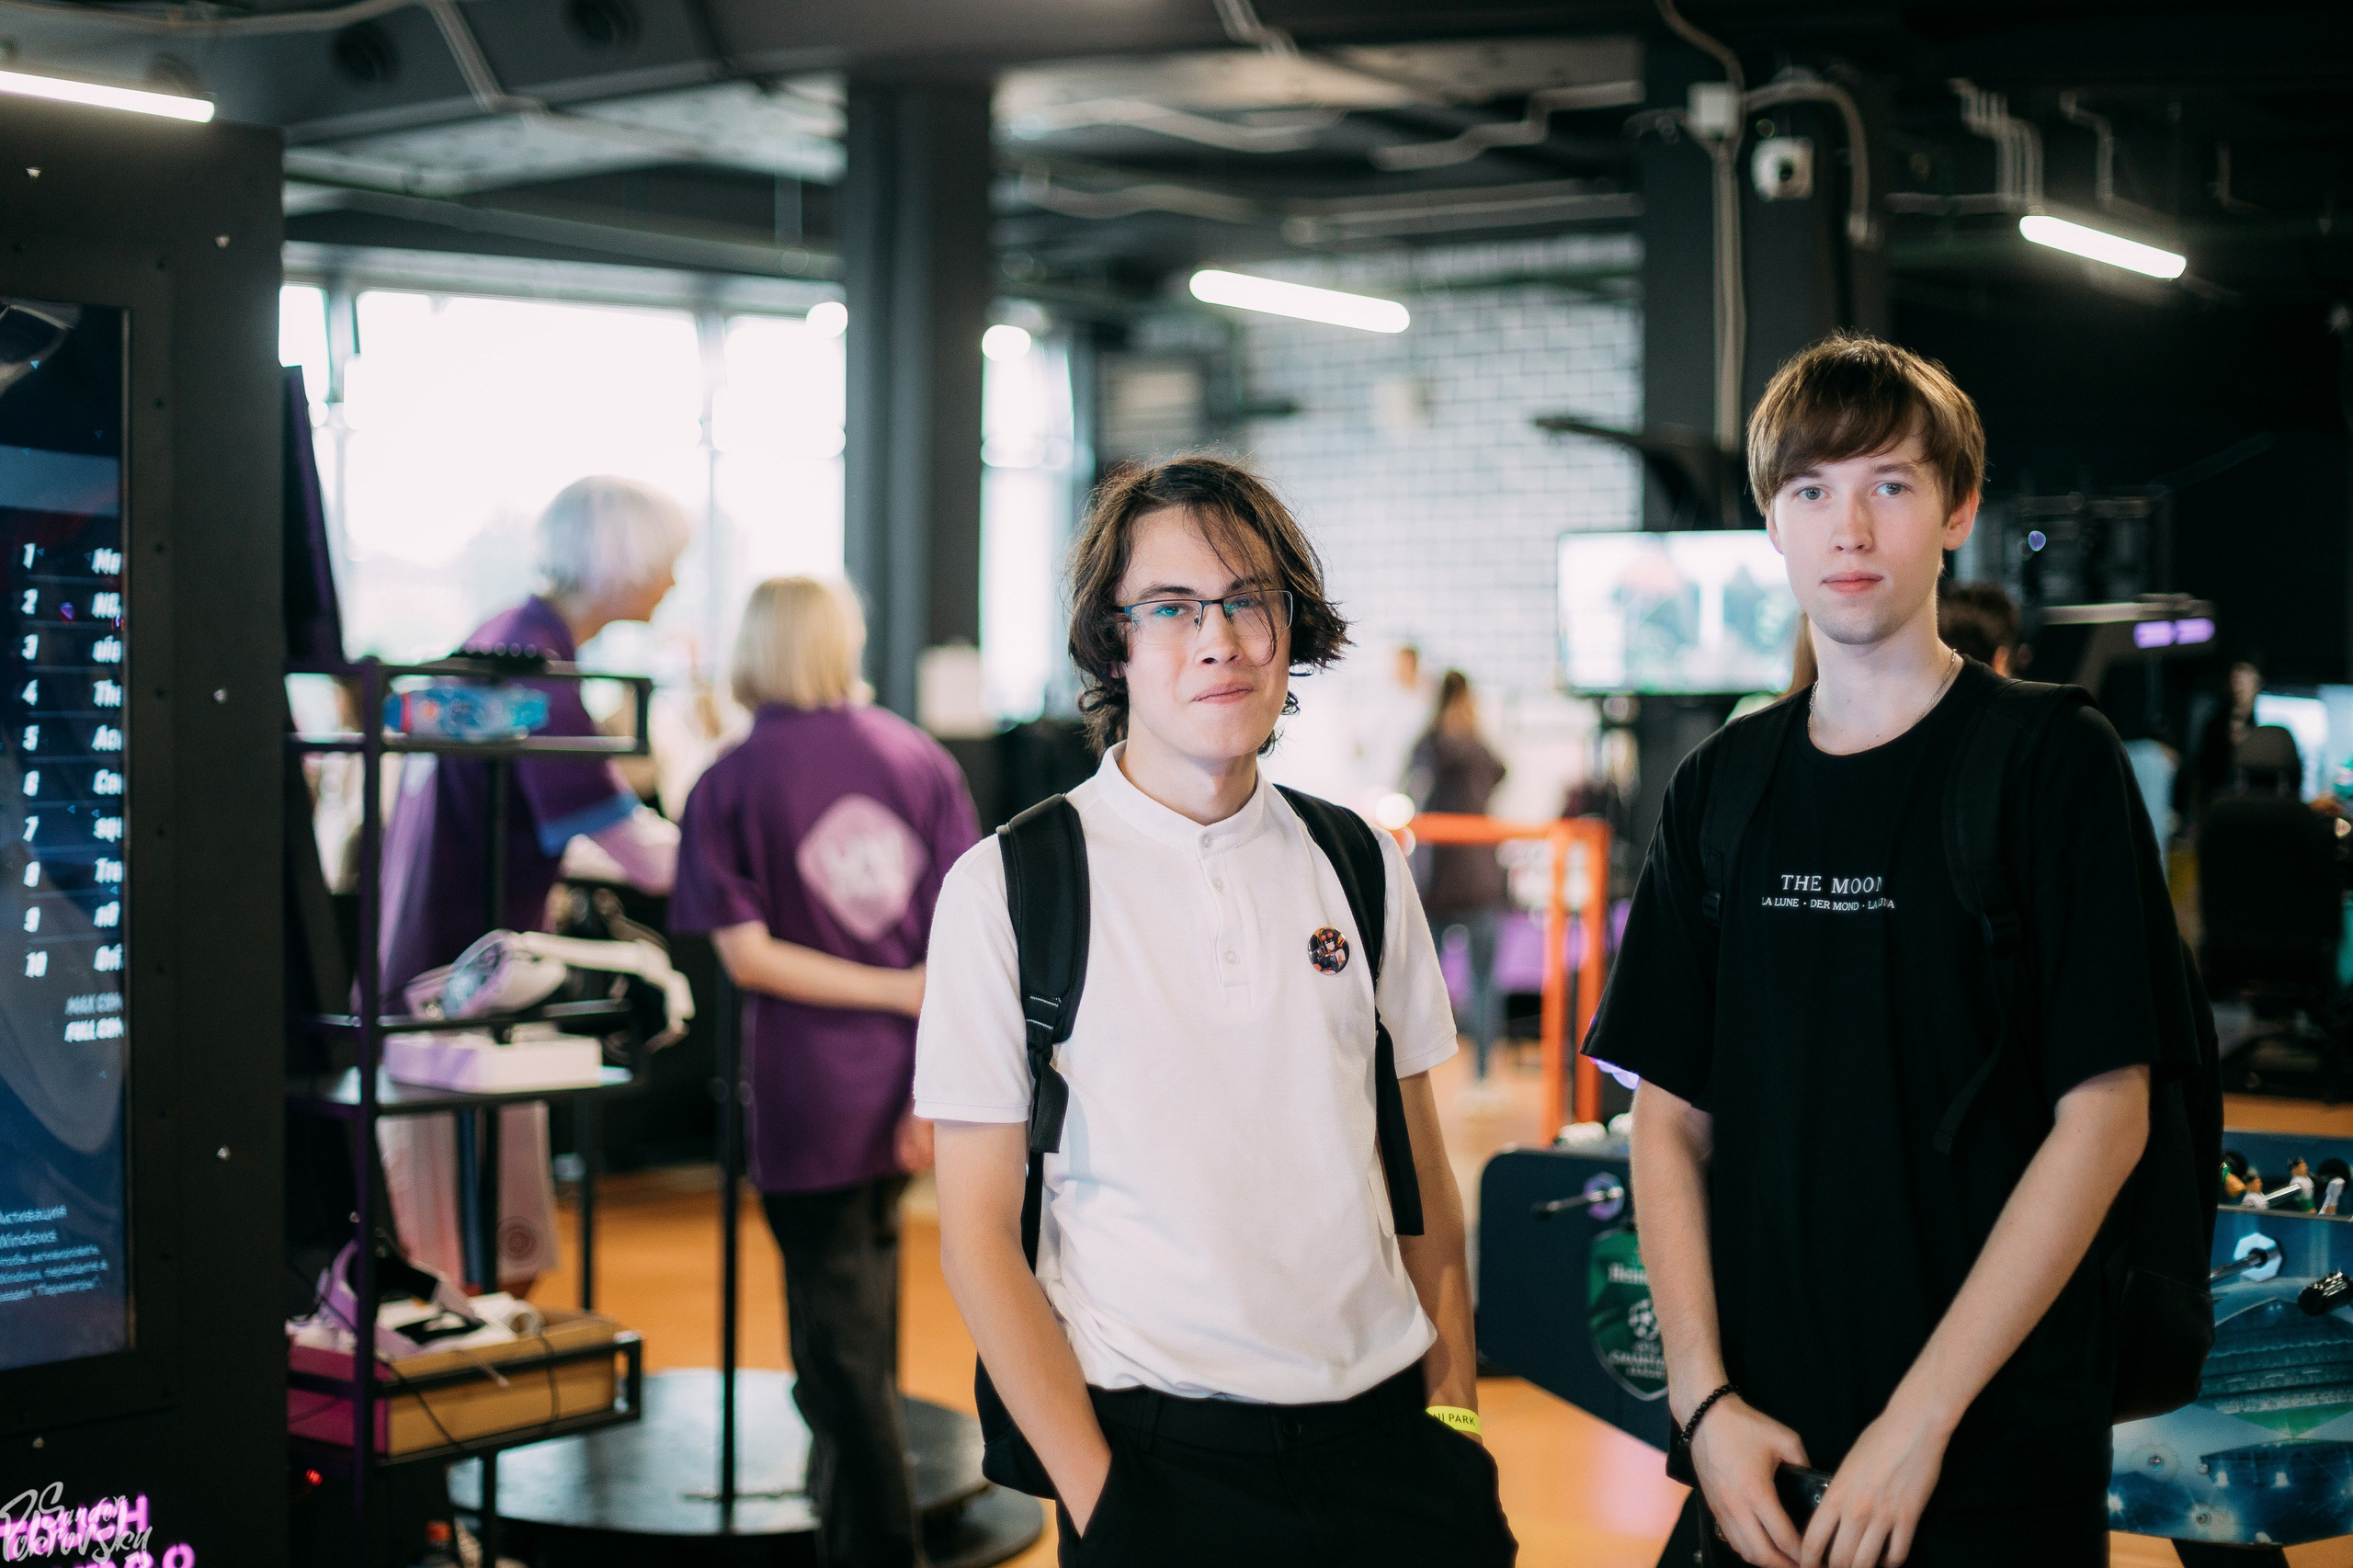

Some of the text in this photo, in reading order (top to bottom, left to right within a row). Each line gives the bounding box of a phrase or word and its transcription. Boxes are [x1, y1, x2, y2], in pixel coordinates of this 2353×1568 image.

[23, 543, 36, 569] 1
[21, 589, 39, 614] 2
[22, 634, 39, 660] 3
[22, 679, 38, 706] 4
[22, 725, 39, 751] 5
[23, 770, 39, 796] 6
[23, 815, 39, 842] 7
[1781, 875, 1822, 892] THE
[1761, 897, 1772, 906] LA
[1774, 898, 1800, 907] LUNE
[1810, 899, 1831, 909] DER
[1832, 902, 1859, 911] MOND
[24, 906, 40, 933] 9
[25, 950, 47, 978] 10
[1449, 1414, 1475, 1426] PARK
